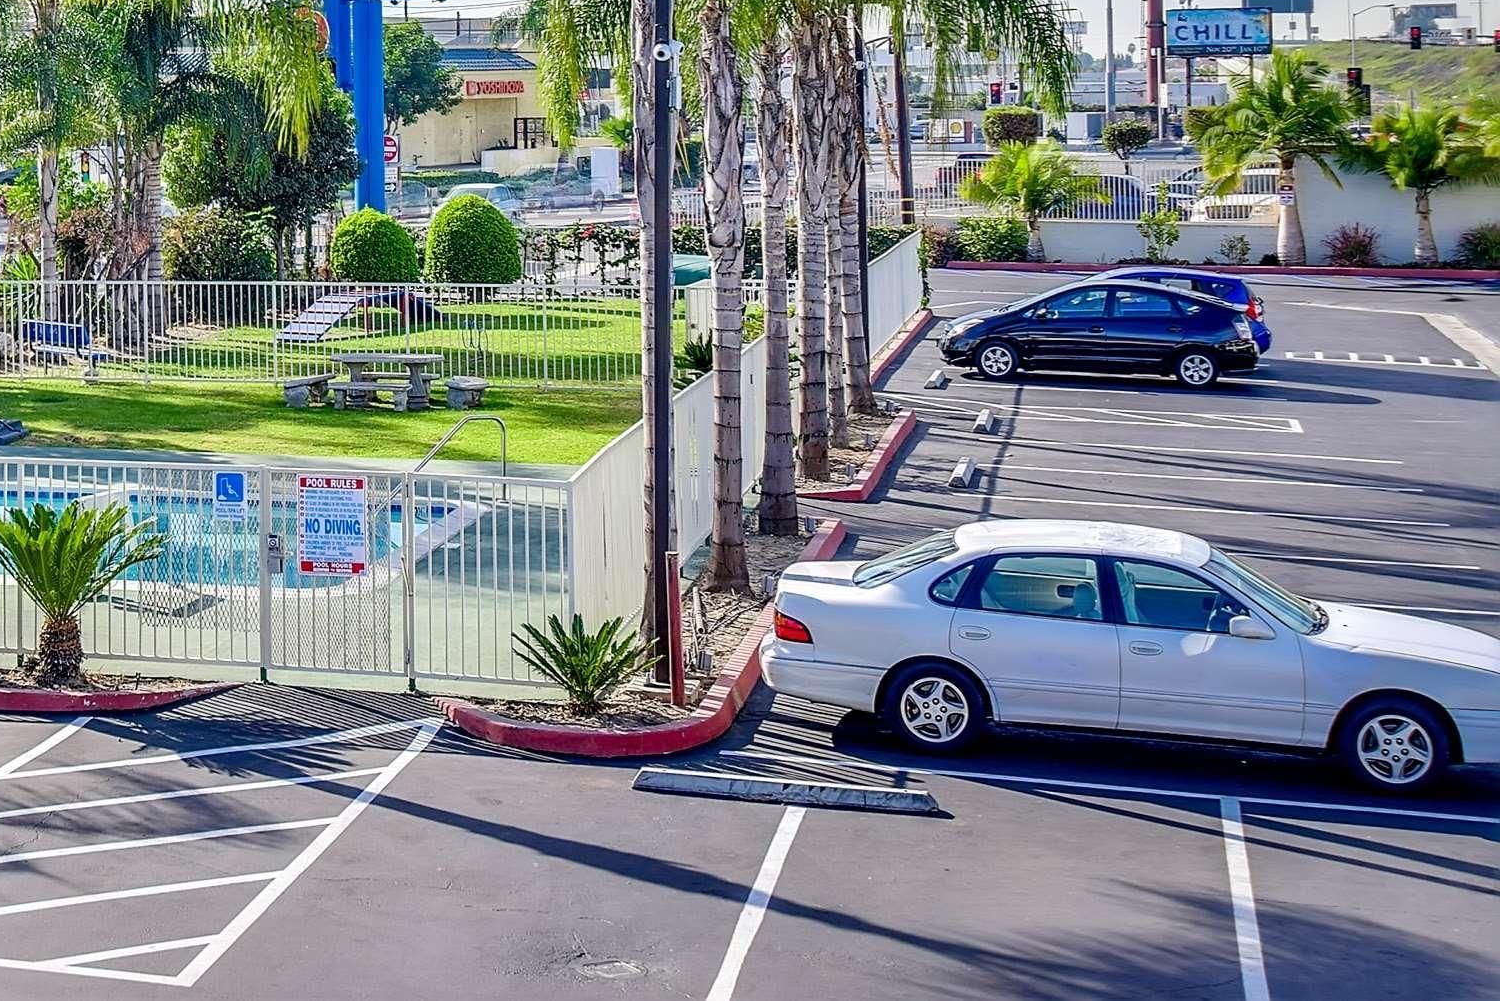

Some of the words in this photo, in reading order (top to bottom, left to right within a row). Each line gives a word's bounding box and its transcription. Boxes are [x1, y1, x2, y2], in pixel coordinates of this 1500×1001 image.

[1175, 24, 1253, 41] CHILL
[306, 479, 328, 488] POOL
[331, 479, 357, 489] RULES
[305, 519, 320, 534] NO
[325, 519, 364, 536] DIVING.
